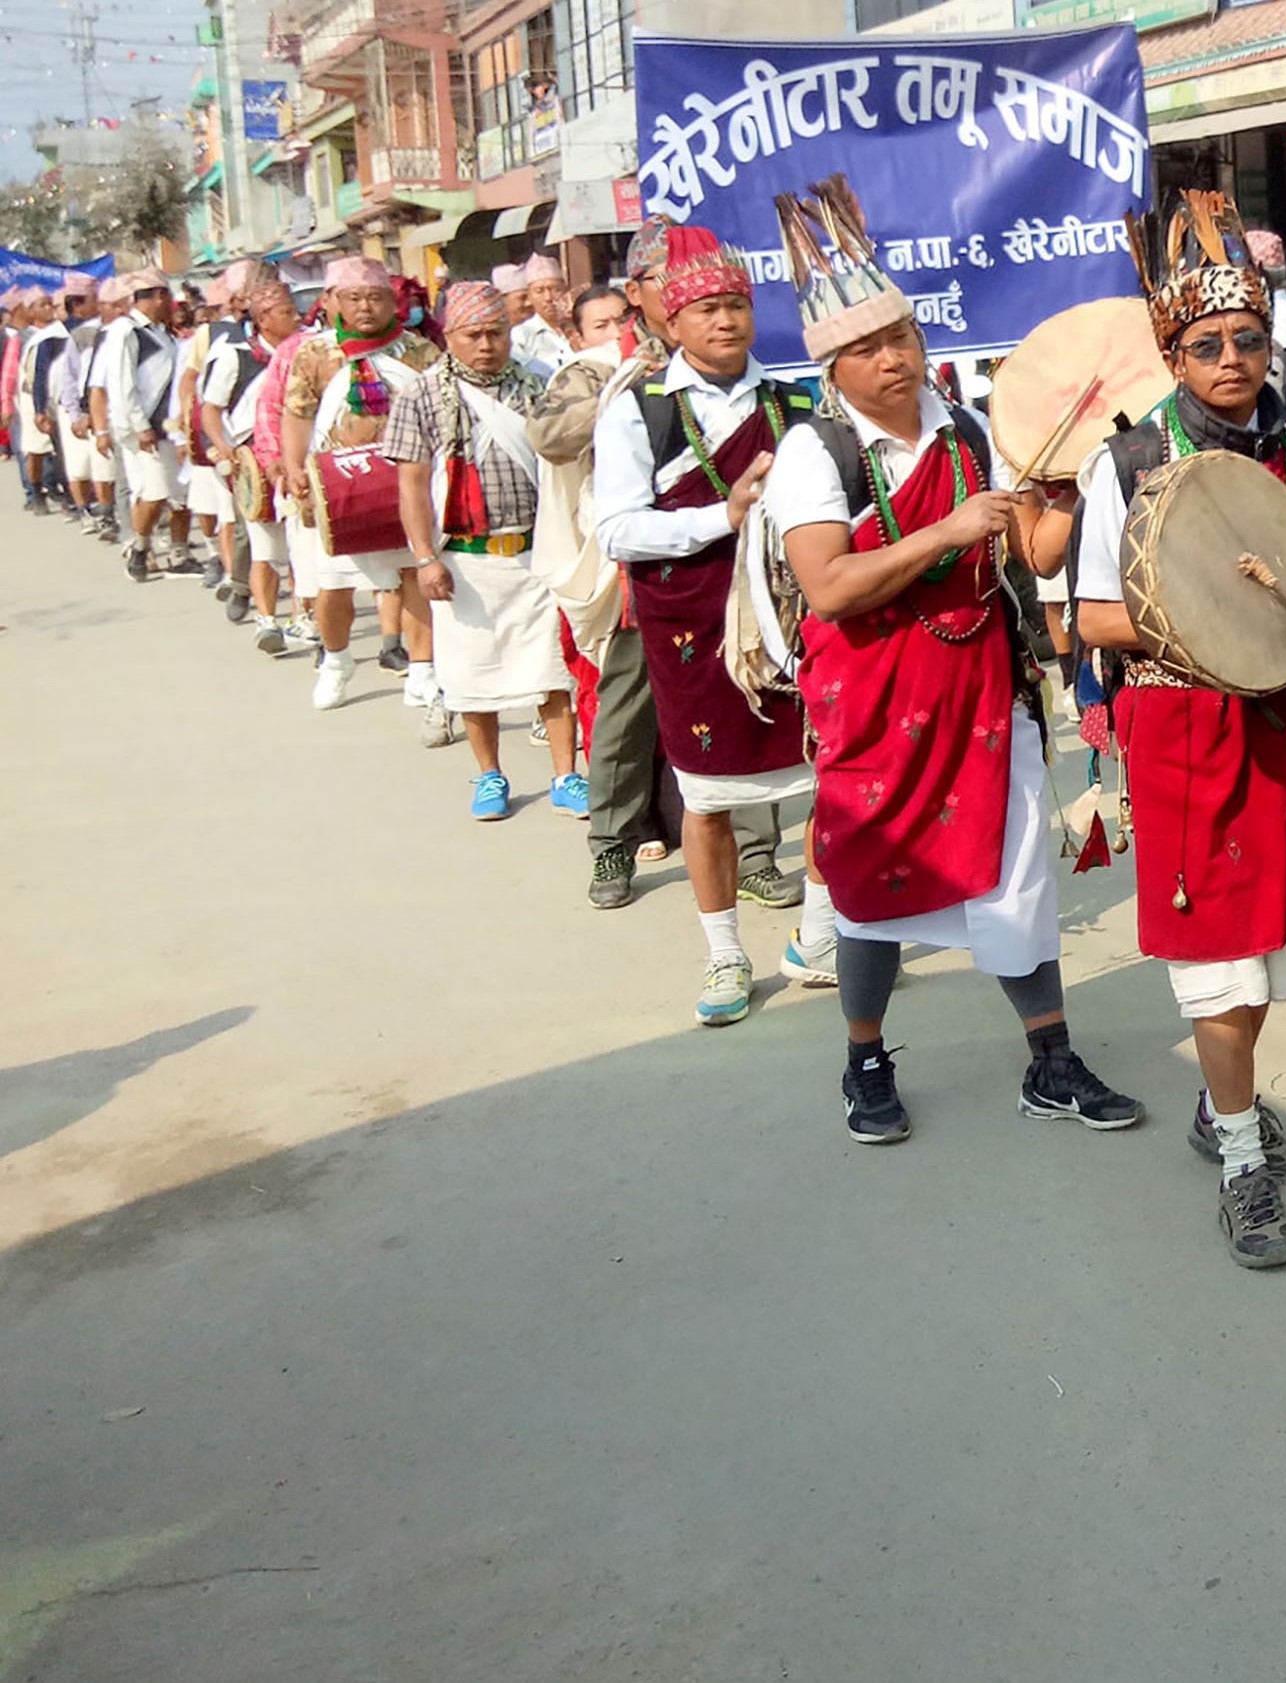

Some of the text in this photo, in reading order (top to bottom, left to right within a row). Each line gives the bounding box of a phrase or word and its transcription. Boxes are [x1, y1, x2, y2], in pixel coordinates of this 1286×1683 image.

[638, 55, 1149, 224] खैरेनीटार तमू समाज
[1001, 214, 1131, 265] खैरेनीटार
[904, 279, 969, 333] नहुँ
